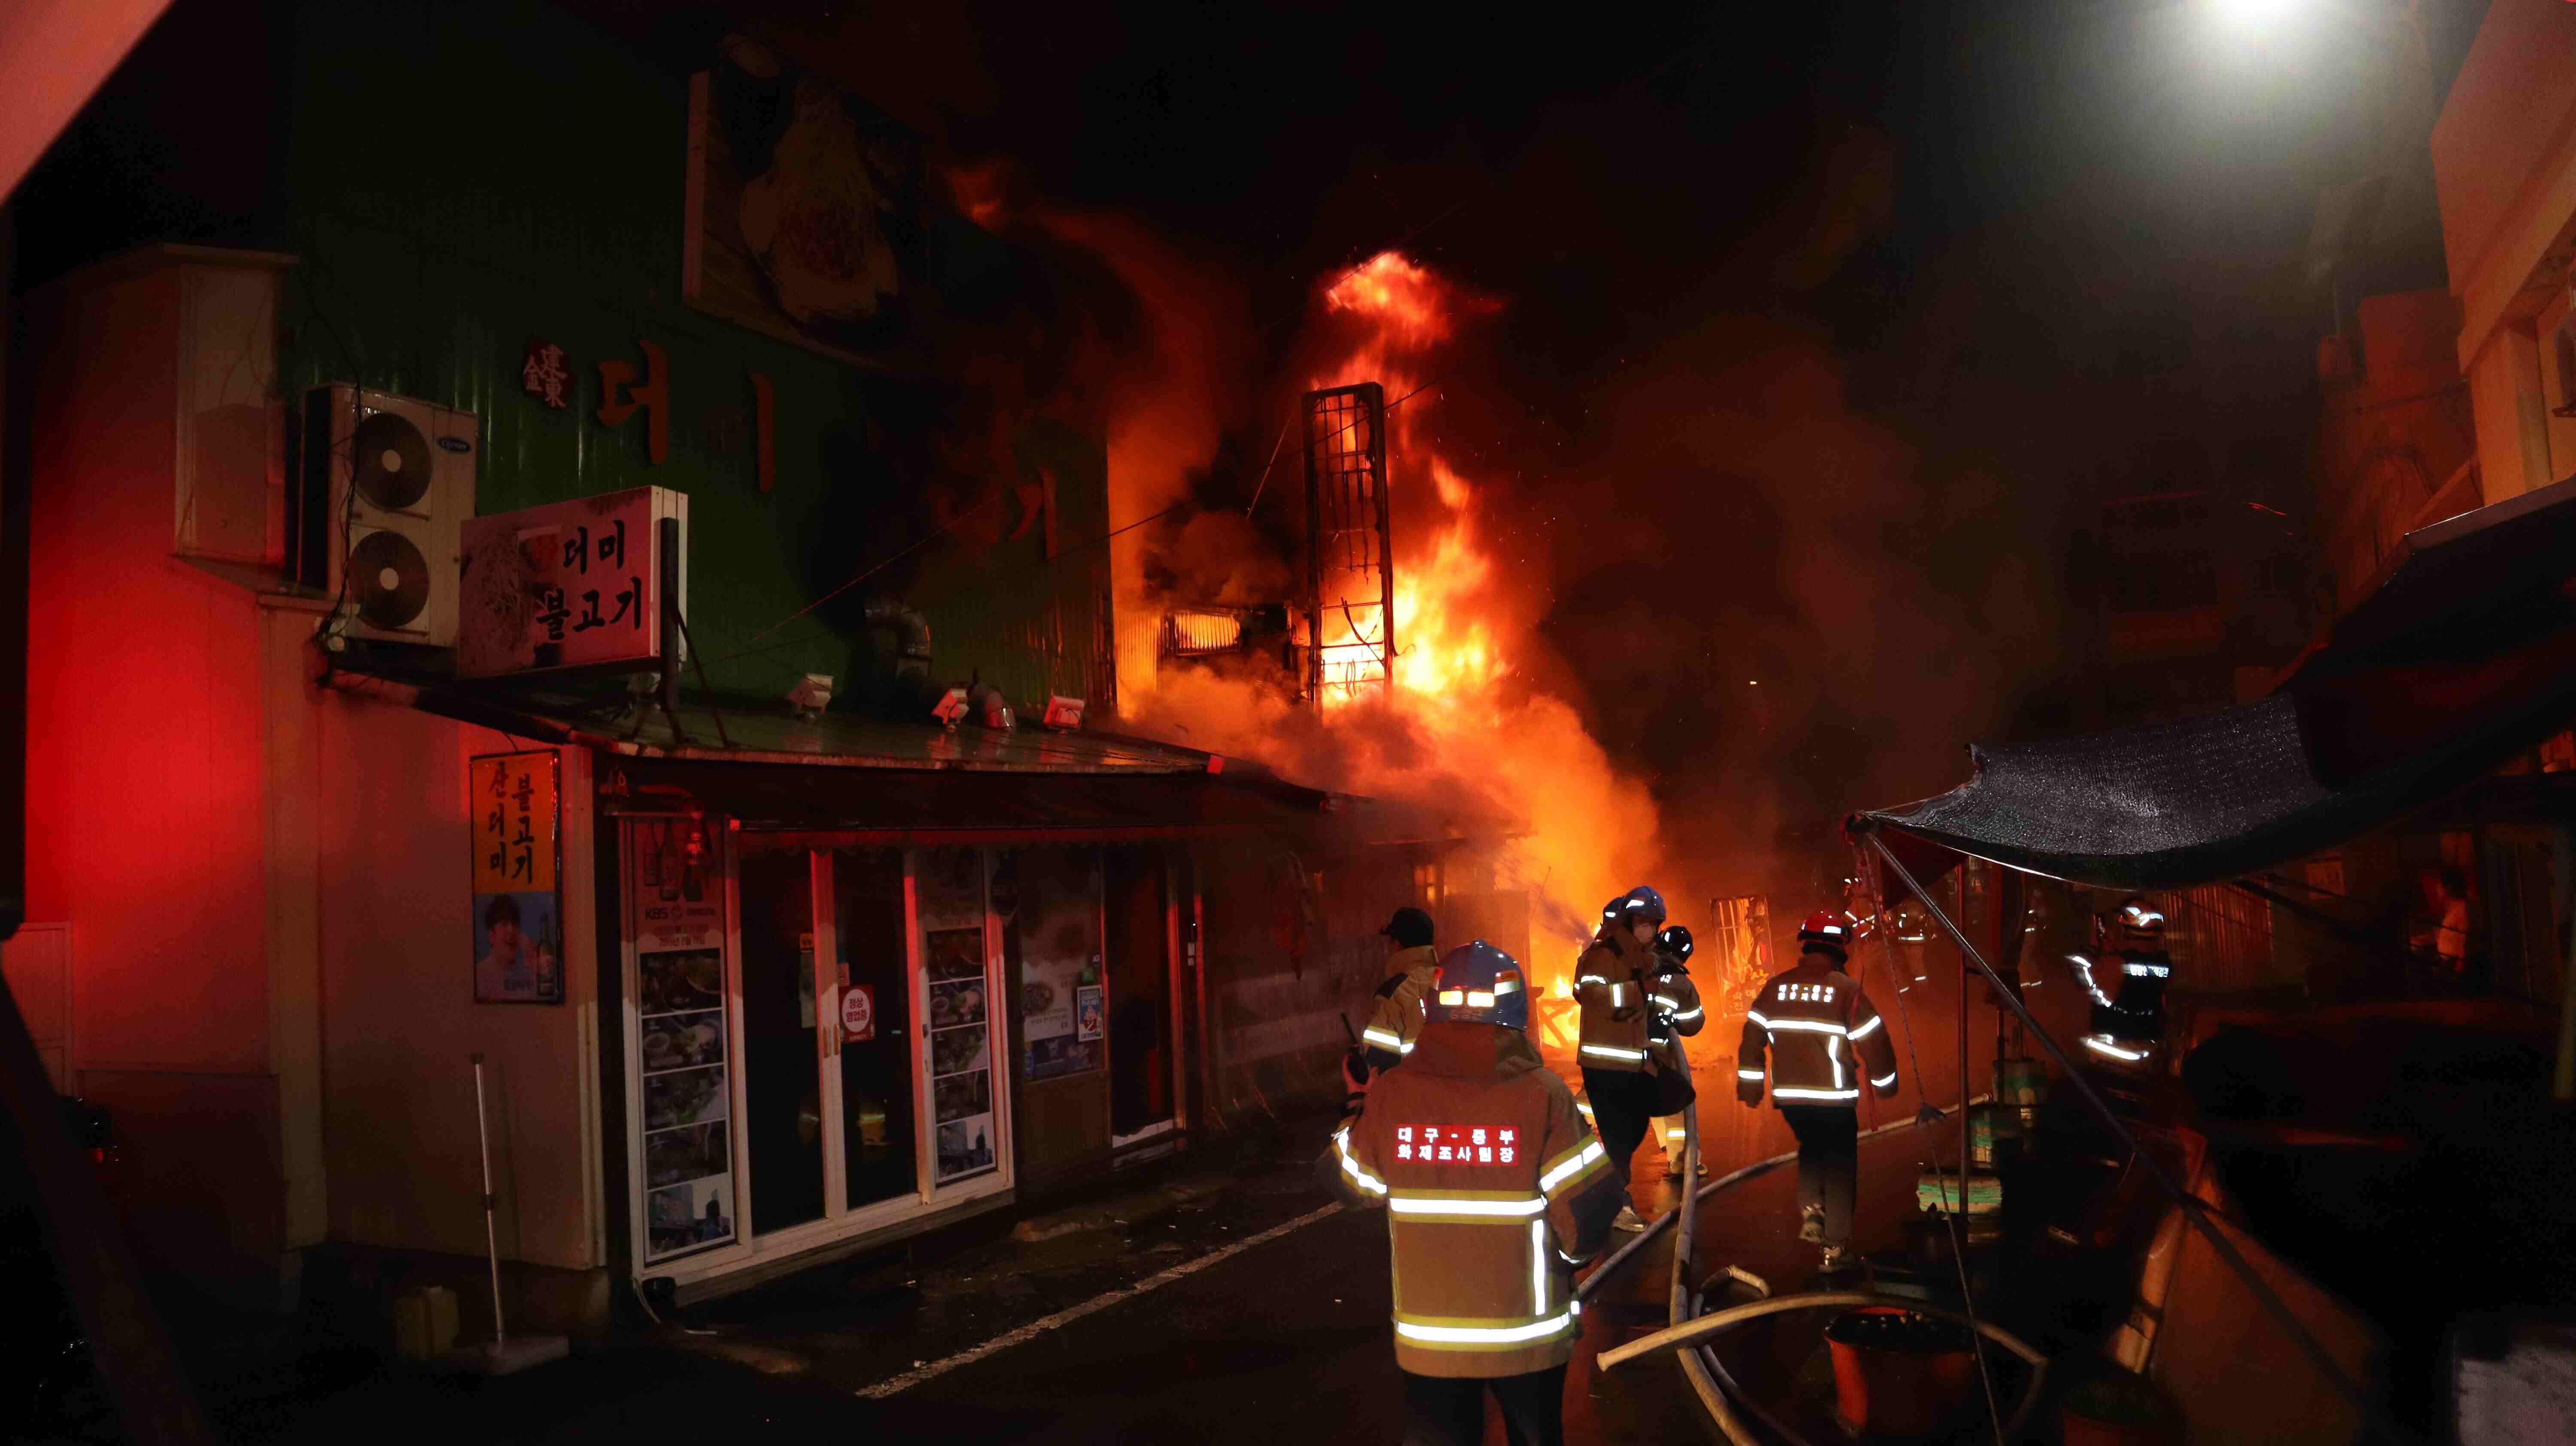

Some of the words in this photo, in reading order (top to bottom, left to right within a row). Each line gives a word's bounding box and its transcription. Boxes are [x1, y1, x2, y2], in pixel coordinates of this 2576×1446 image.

[563, 519, 624, 575] 더미
[536, 576, 641, 641] 불고기
[512, 773, 535, 884] 불고기
